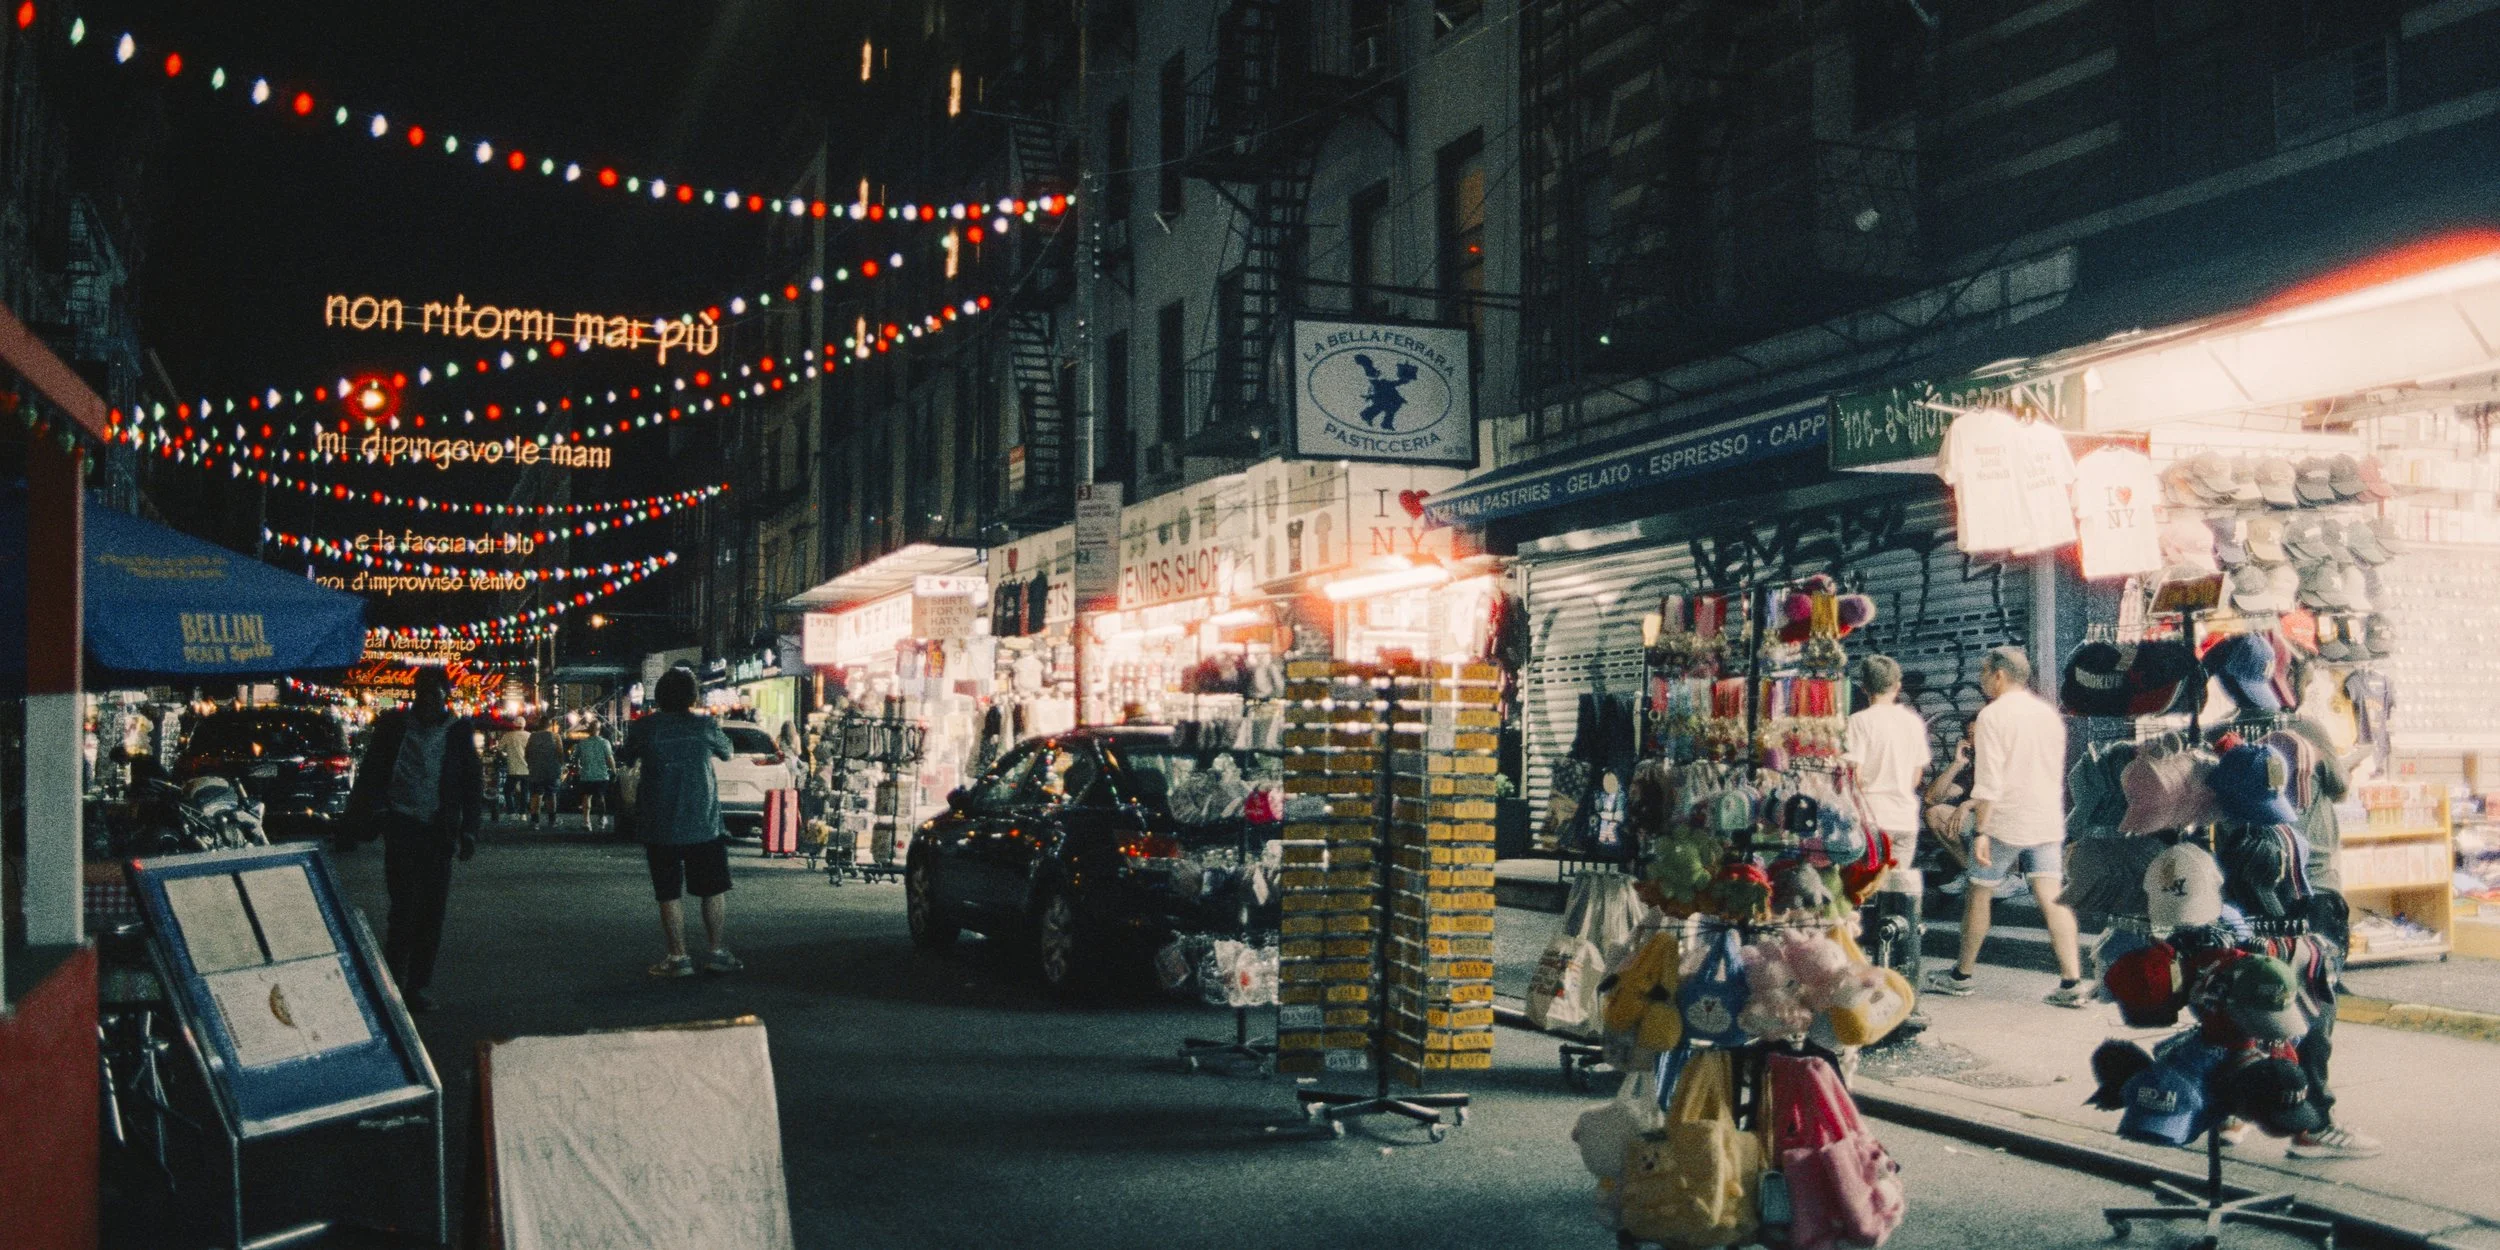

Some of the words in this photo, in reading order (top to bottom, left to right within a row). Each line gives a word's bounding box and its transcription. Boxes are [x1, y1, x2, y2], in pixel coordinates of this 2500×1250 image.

[326, 293, 402, 330] non
[424, 294, 554, 342] ritorni
[574, 311, 639, 349] mai
[657, 310, 719, 365] più
[1303, 342, 1325, 362] LA
[1328, 330, 1380, 347] BELLA
[1384, 332, 1454, 376] FERRARA
[316, 431, 346, 454] mi
[362, 427, 503, 469] dipingevo
[514, 435, 540, 464] le
[551, 442, 611, 469] mani
[1324, 422, 1441, 453] PASTICCERIA
[1483, 482, 1550, 512] PASTRIES
[1567, 459, 1631, 496] GELATO
[1649, 434, 1749, 477] ESPRESSO
[1769, 413, 1827, 448] CAPP
[1374, 488, 1389, 518] I
[2104, 486, 2112, 507] I
[2106, 508, 2135, 529] NY
[355, 533, 369, 550] e
[378, 529, 395, 552] la
[404, 529, 466, 553] faccia
[475, 532, 494, 554] di
[504, 531, 534, 554] blu
[1370, 526, 1428, 556] NY
[352, 571, 463, 596] d'improvviso
[470, 576, 526, 591] venivo
[924, 579, 932, 591] I
[957, 579, 983, 592] NY
[931, 607, 953, 616] FOR
[958, 606, 970, 616] 10
[931, 617, 960, 626] HATS
[179, 612, 266, 644] BELLINI
[931, 628, 953, 637] FOR
[958, 627, 970, 636] 10
[182, 646, 226, 663] PEACH
[1455, 962, 1487, 974] RYAN
[1458, 987, 1487, 998] SAM
[1457, 1035, 1489, 1046] SARA
[1453, 1055, 1488, 1067] SCOTT
[2138, 1087, 2178, 1104] BIDN
